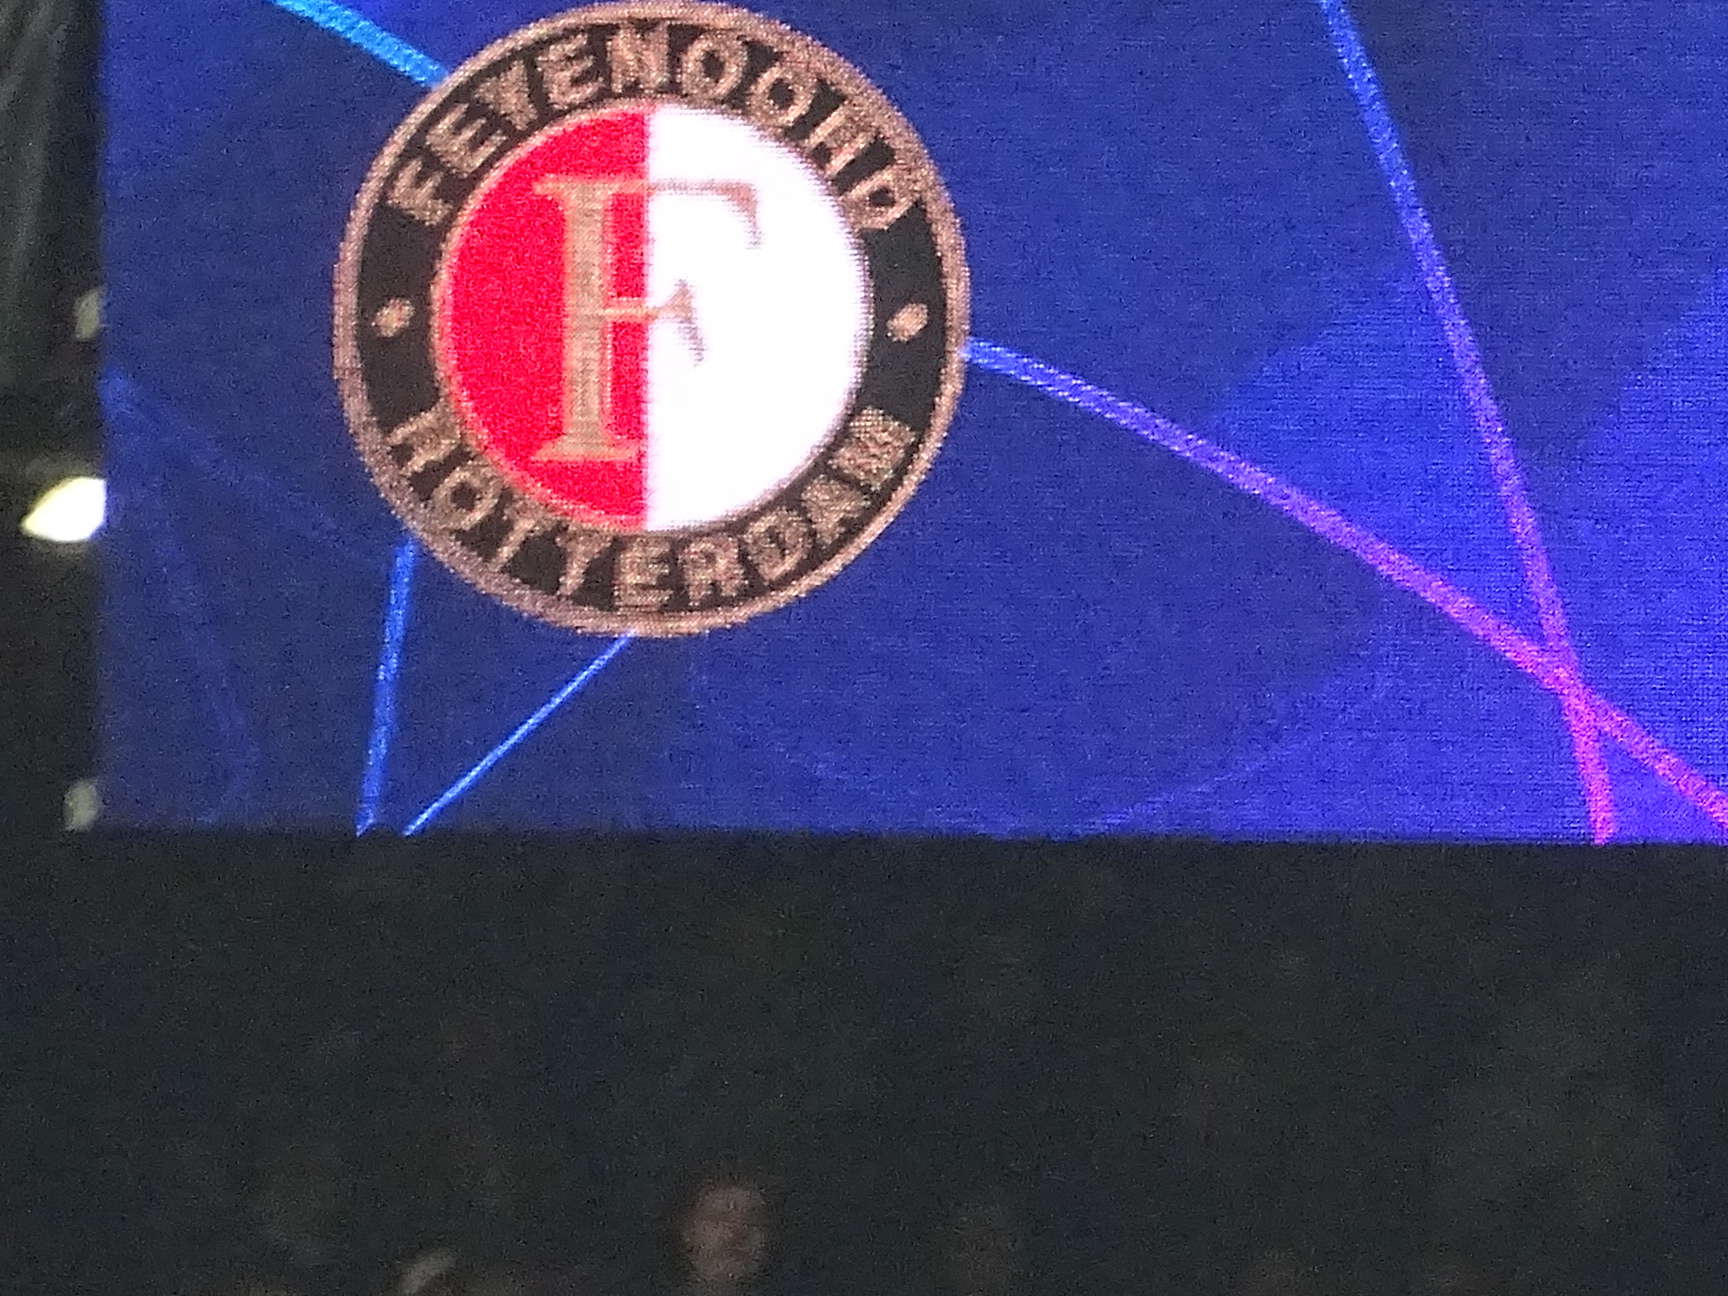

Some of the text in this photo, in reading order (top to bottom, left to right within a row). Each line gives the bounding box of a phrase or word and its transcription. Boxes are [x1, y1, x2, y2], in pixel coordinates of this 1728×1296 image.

[384, 19, 922, 232] FEYENOORD
[532, 172, 764, 464] F
[384, 406, 917, 610] ROTTERDAM
